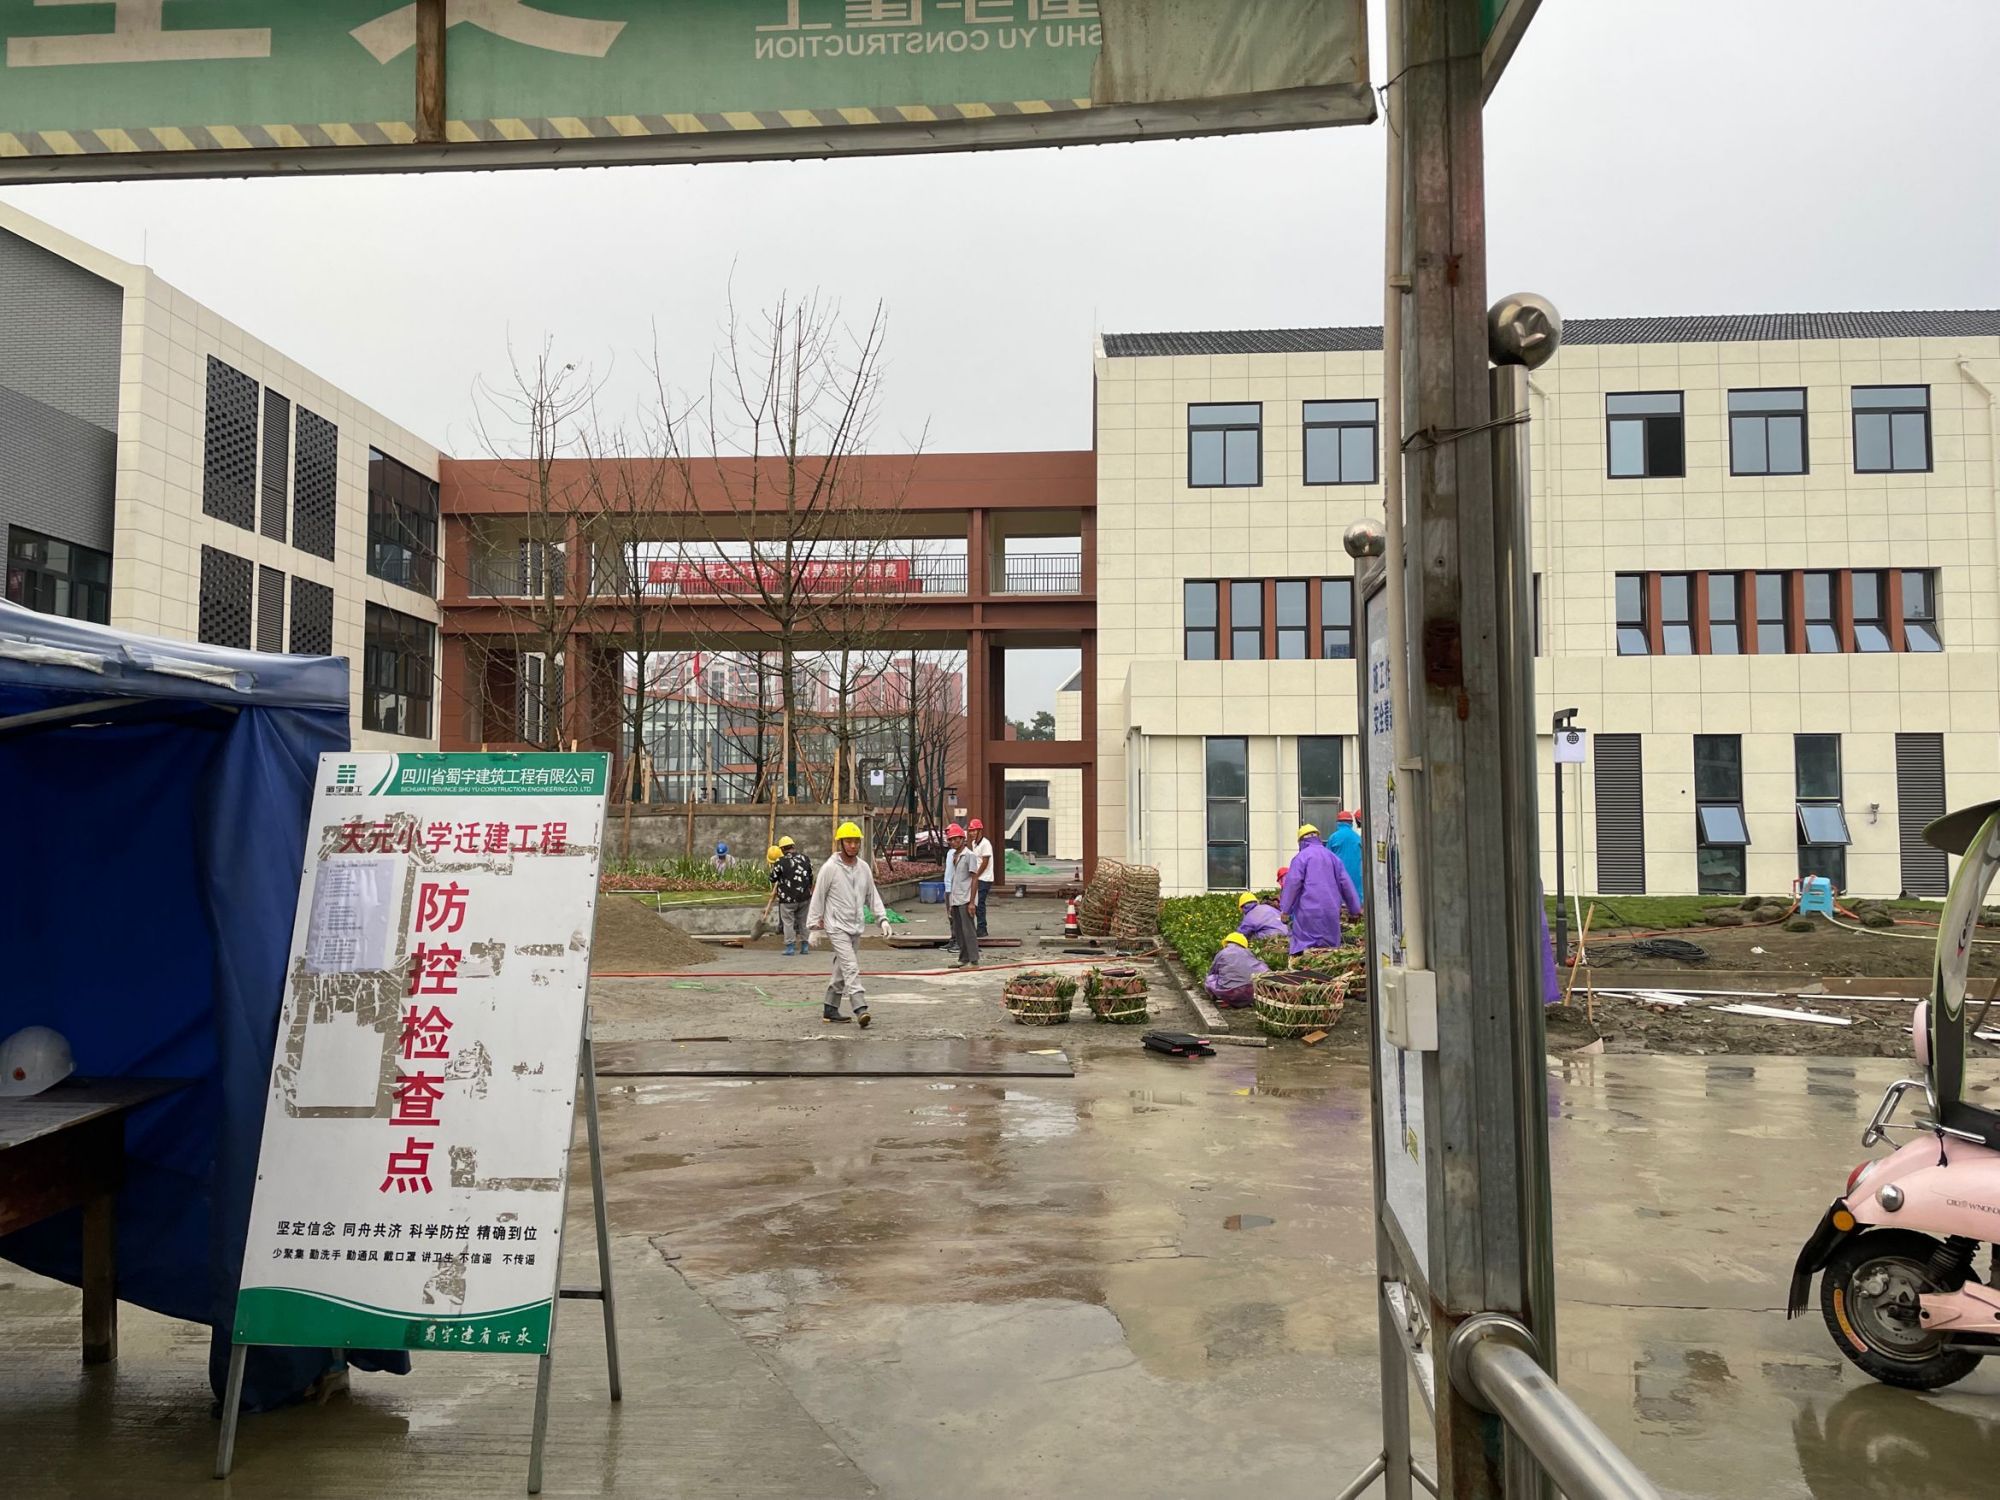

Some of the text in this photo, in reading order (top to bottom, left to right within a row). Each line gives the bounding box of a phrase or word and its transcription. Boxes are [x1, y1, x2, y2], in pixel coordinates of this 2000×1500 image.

[401, 768, 595, 785] 四川省蜀宇建筑工程有限公司
[339, 821, 567, 854] 天元小学迁建工程
[379, 881, 469, 1194] 防控检查点
[276, 1220, 537, 1241] 坚定信念 同舟共济 科学防控 精确到位
[272, 1247, 535, 1265] 少聚集 勤洗手 勤通风 戴口罩 讲卫生 不信谣 不传谣
